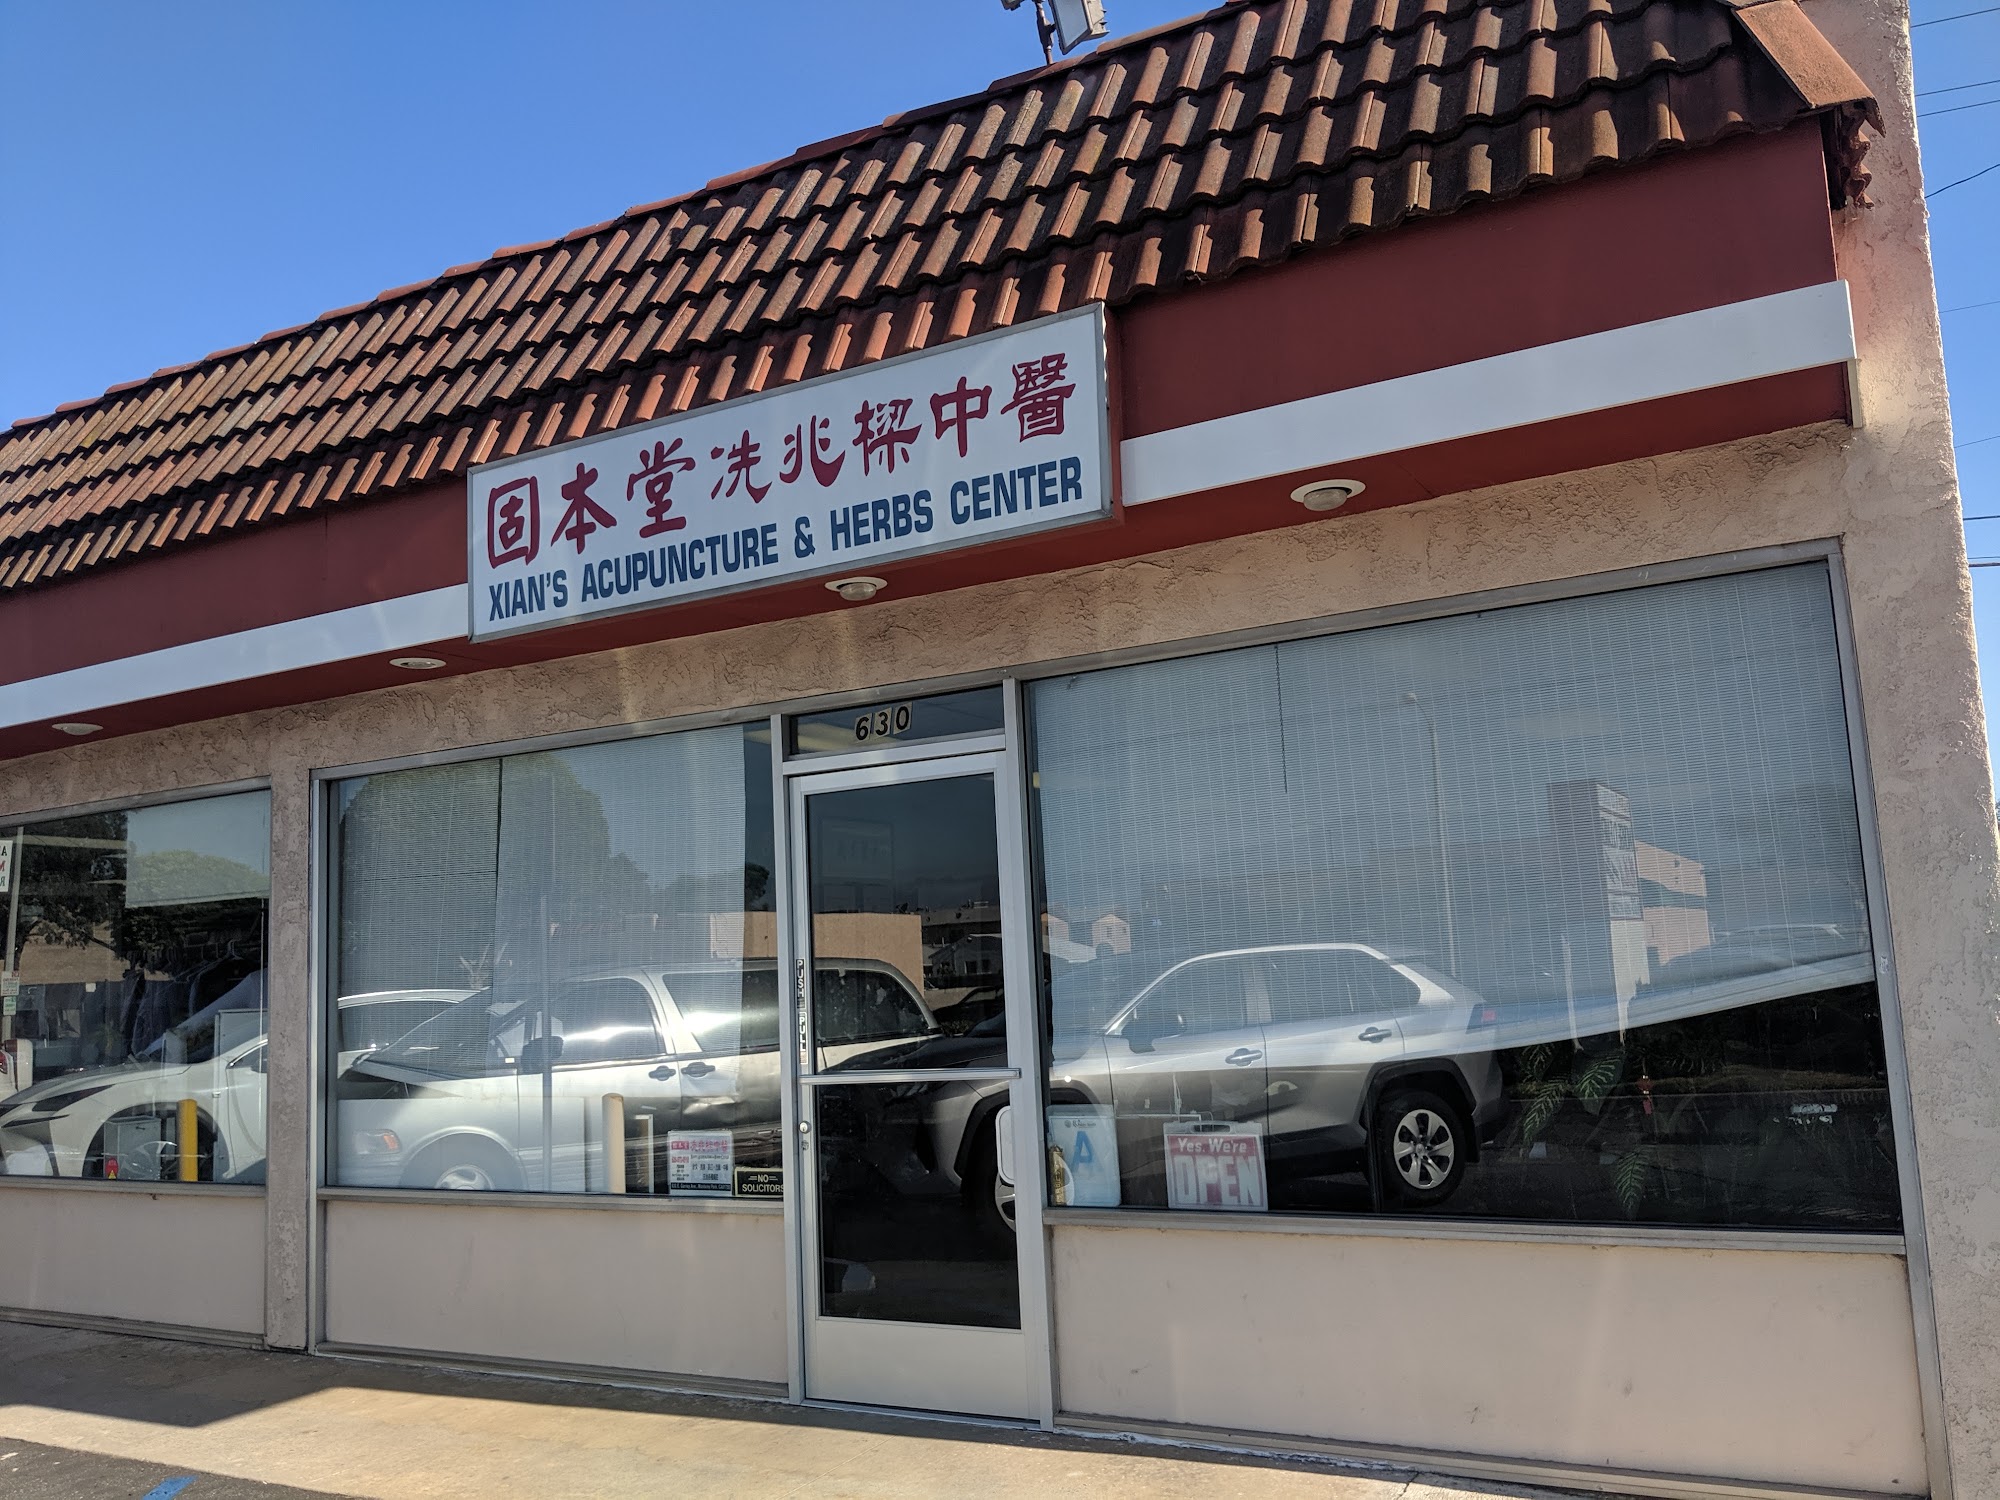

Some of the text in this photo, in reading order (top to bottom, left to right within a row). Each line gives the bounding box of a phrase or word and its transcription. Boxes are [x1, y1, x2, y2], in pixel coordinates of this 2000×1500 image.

[489, 456, 1083, 621] XIAN'S ACUPUNCTURE & HERBS CENTER
[856, 706, 910, 741] 630
[1071, 1131, 1102, 1172] A
[1208, 1137, 1247, 1153] We're
[757, 1174, 769, 1183] NO
[1173, 1154, 1262, 1207] OPEN
